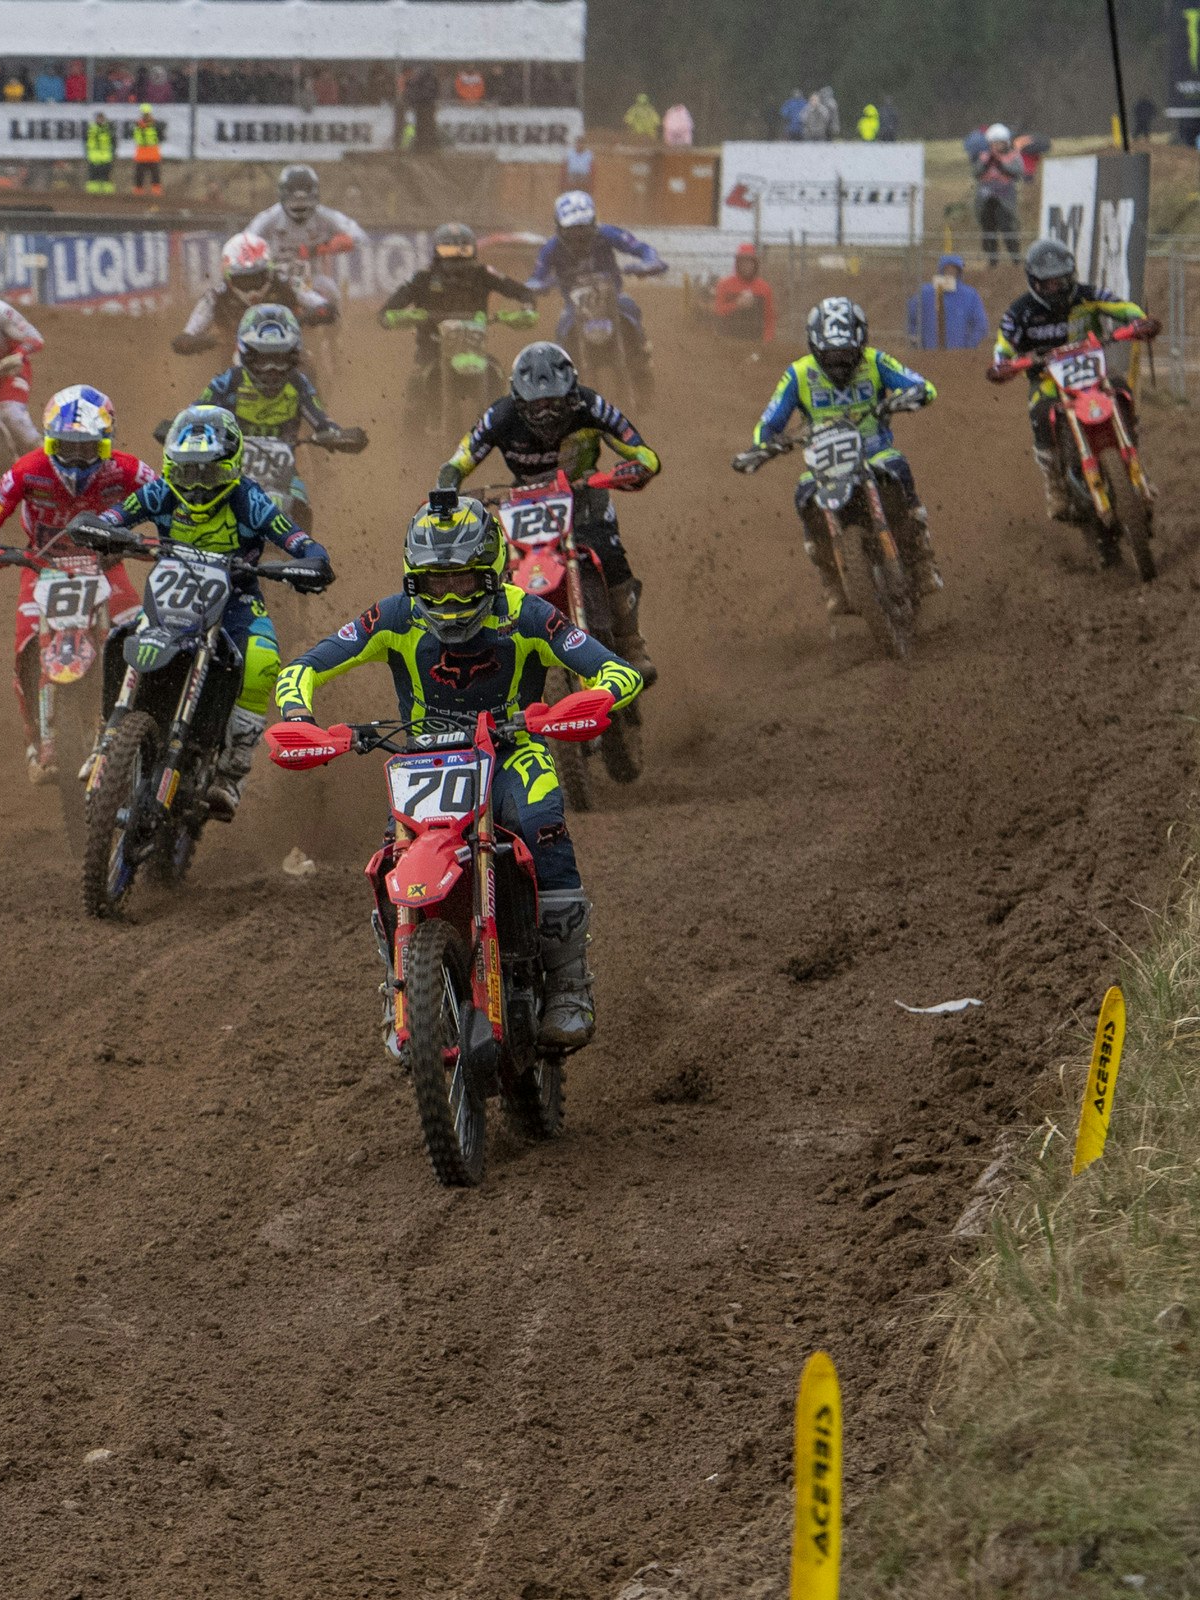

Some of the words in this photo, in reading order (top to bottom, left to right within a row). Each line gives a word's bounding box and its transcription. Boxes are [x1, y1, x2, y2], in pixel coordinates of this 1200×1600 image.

[215, 120, 372, 143] LIEBHERR
[52, 229, 169, 298] LIQUI
[510, 504, 567, 541] 128
[46, 579, 99, 618] 61
[153, 570, 228, 615] 259
[540, 719, 598, 733] ACERBIS
[278, 747, 337, 758] ACERBIS
[403, 768, 477, 817] 70
[1093, 1020, 1116, 1116] ACERBIS
[810, 1403, 832, 1558] ACERBIS
